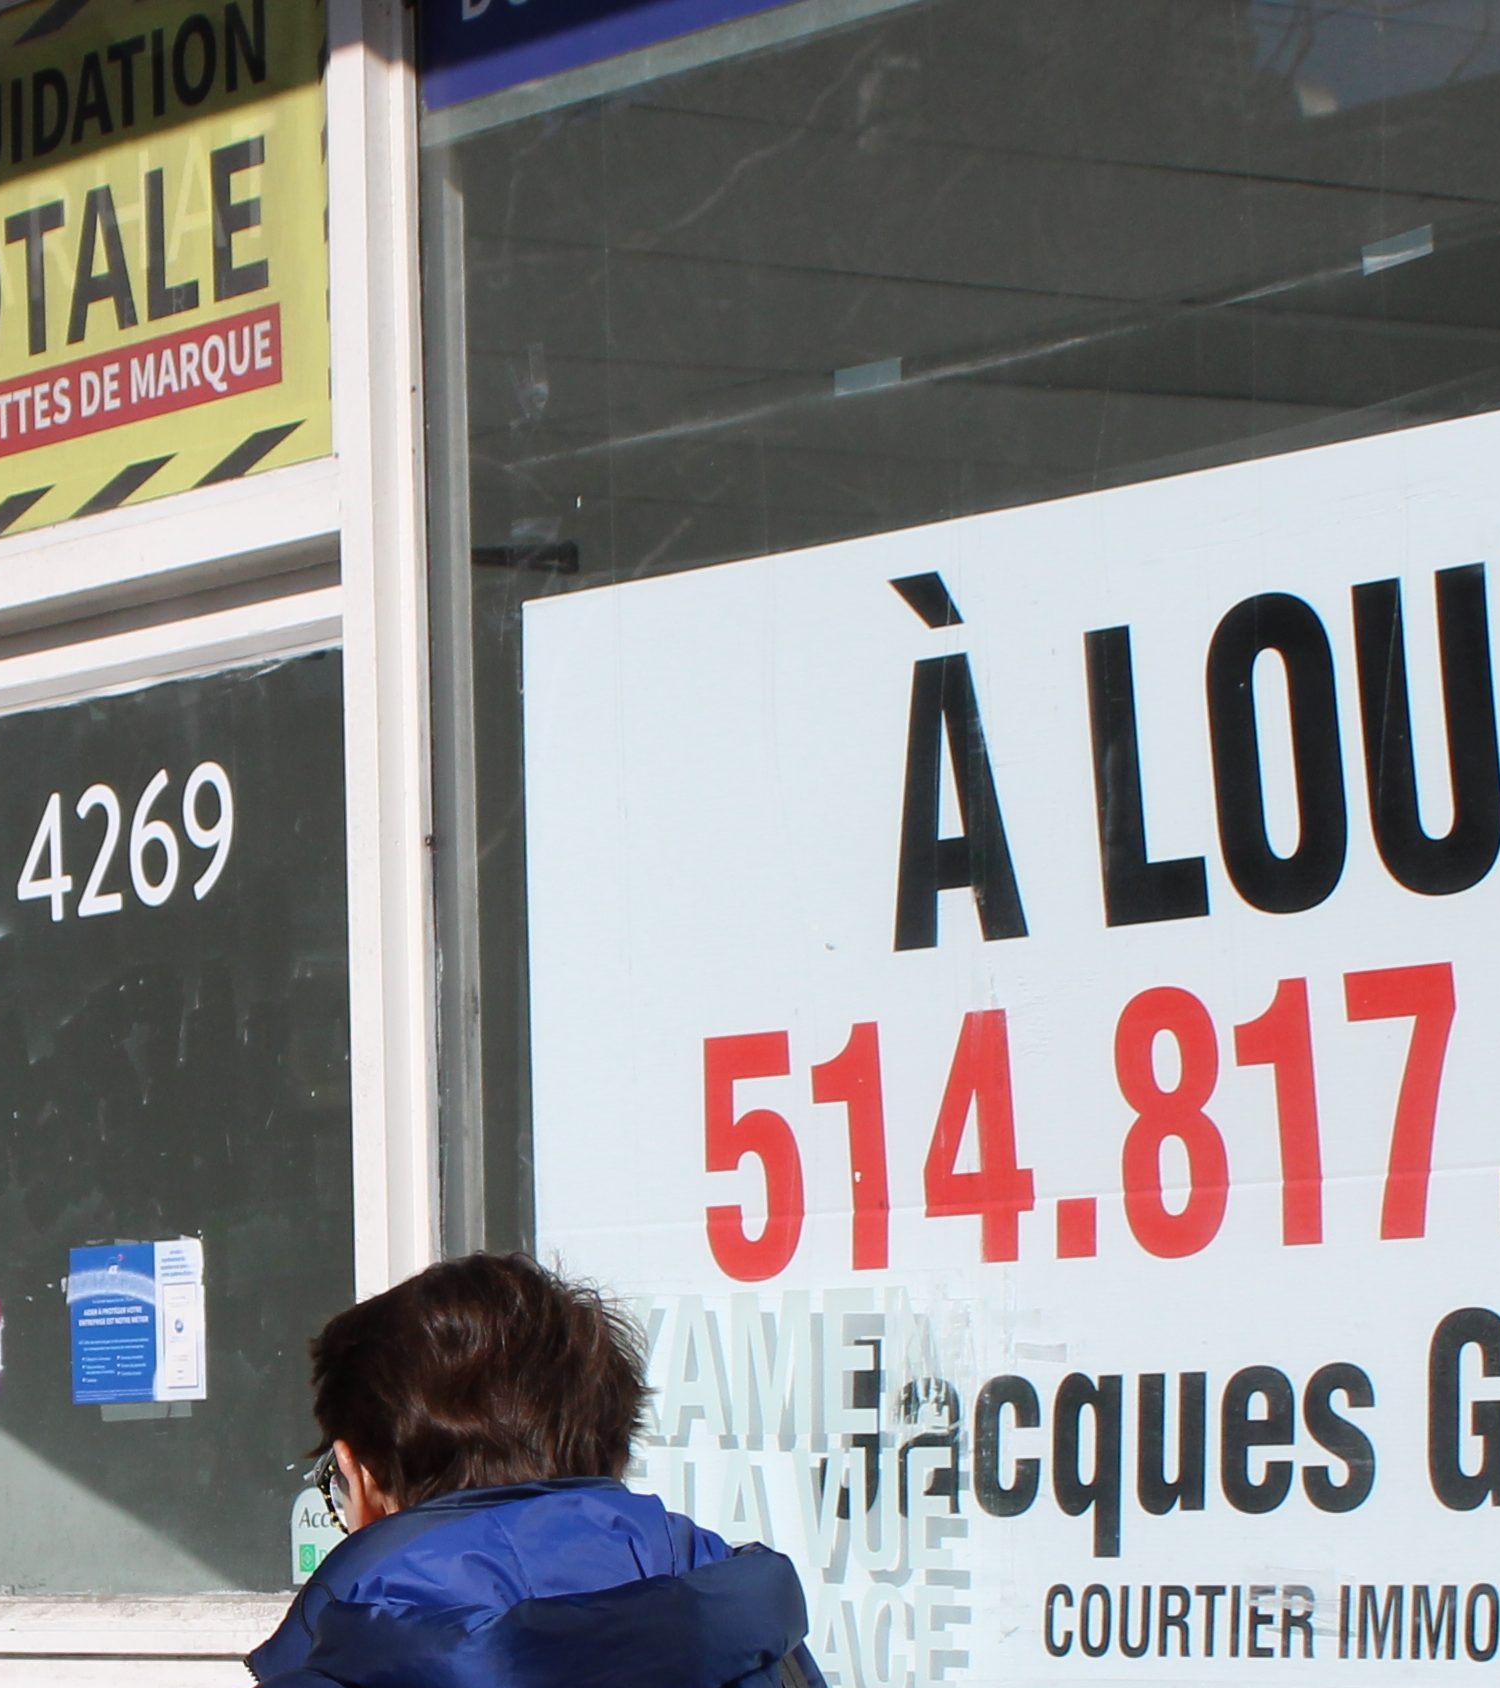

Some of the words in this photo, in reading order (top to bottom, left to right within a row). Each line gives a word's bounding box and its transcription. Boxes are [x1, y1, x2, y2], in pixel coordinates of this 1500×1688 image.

[80, 363, 120, 417] DE
[130, 320, 273, 403] MARQUE
[887, 571, 1030, 951] À
[17, 760, 235, 923] 4269
[791, 1446, 953, 1570] VUE
[1044, 1582, 1315, 1660] COURTIER
